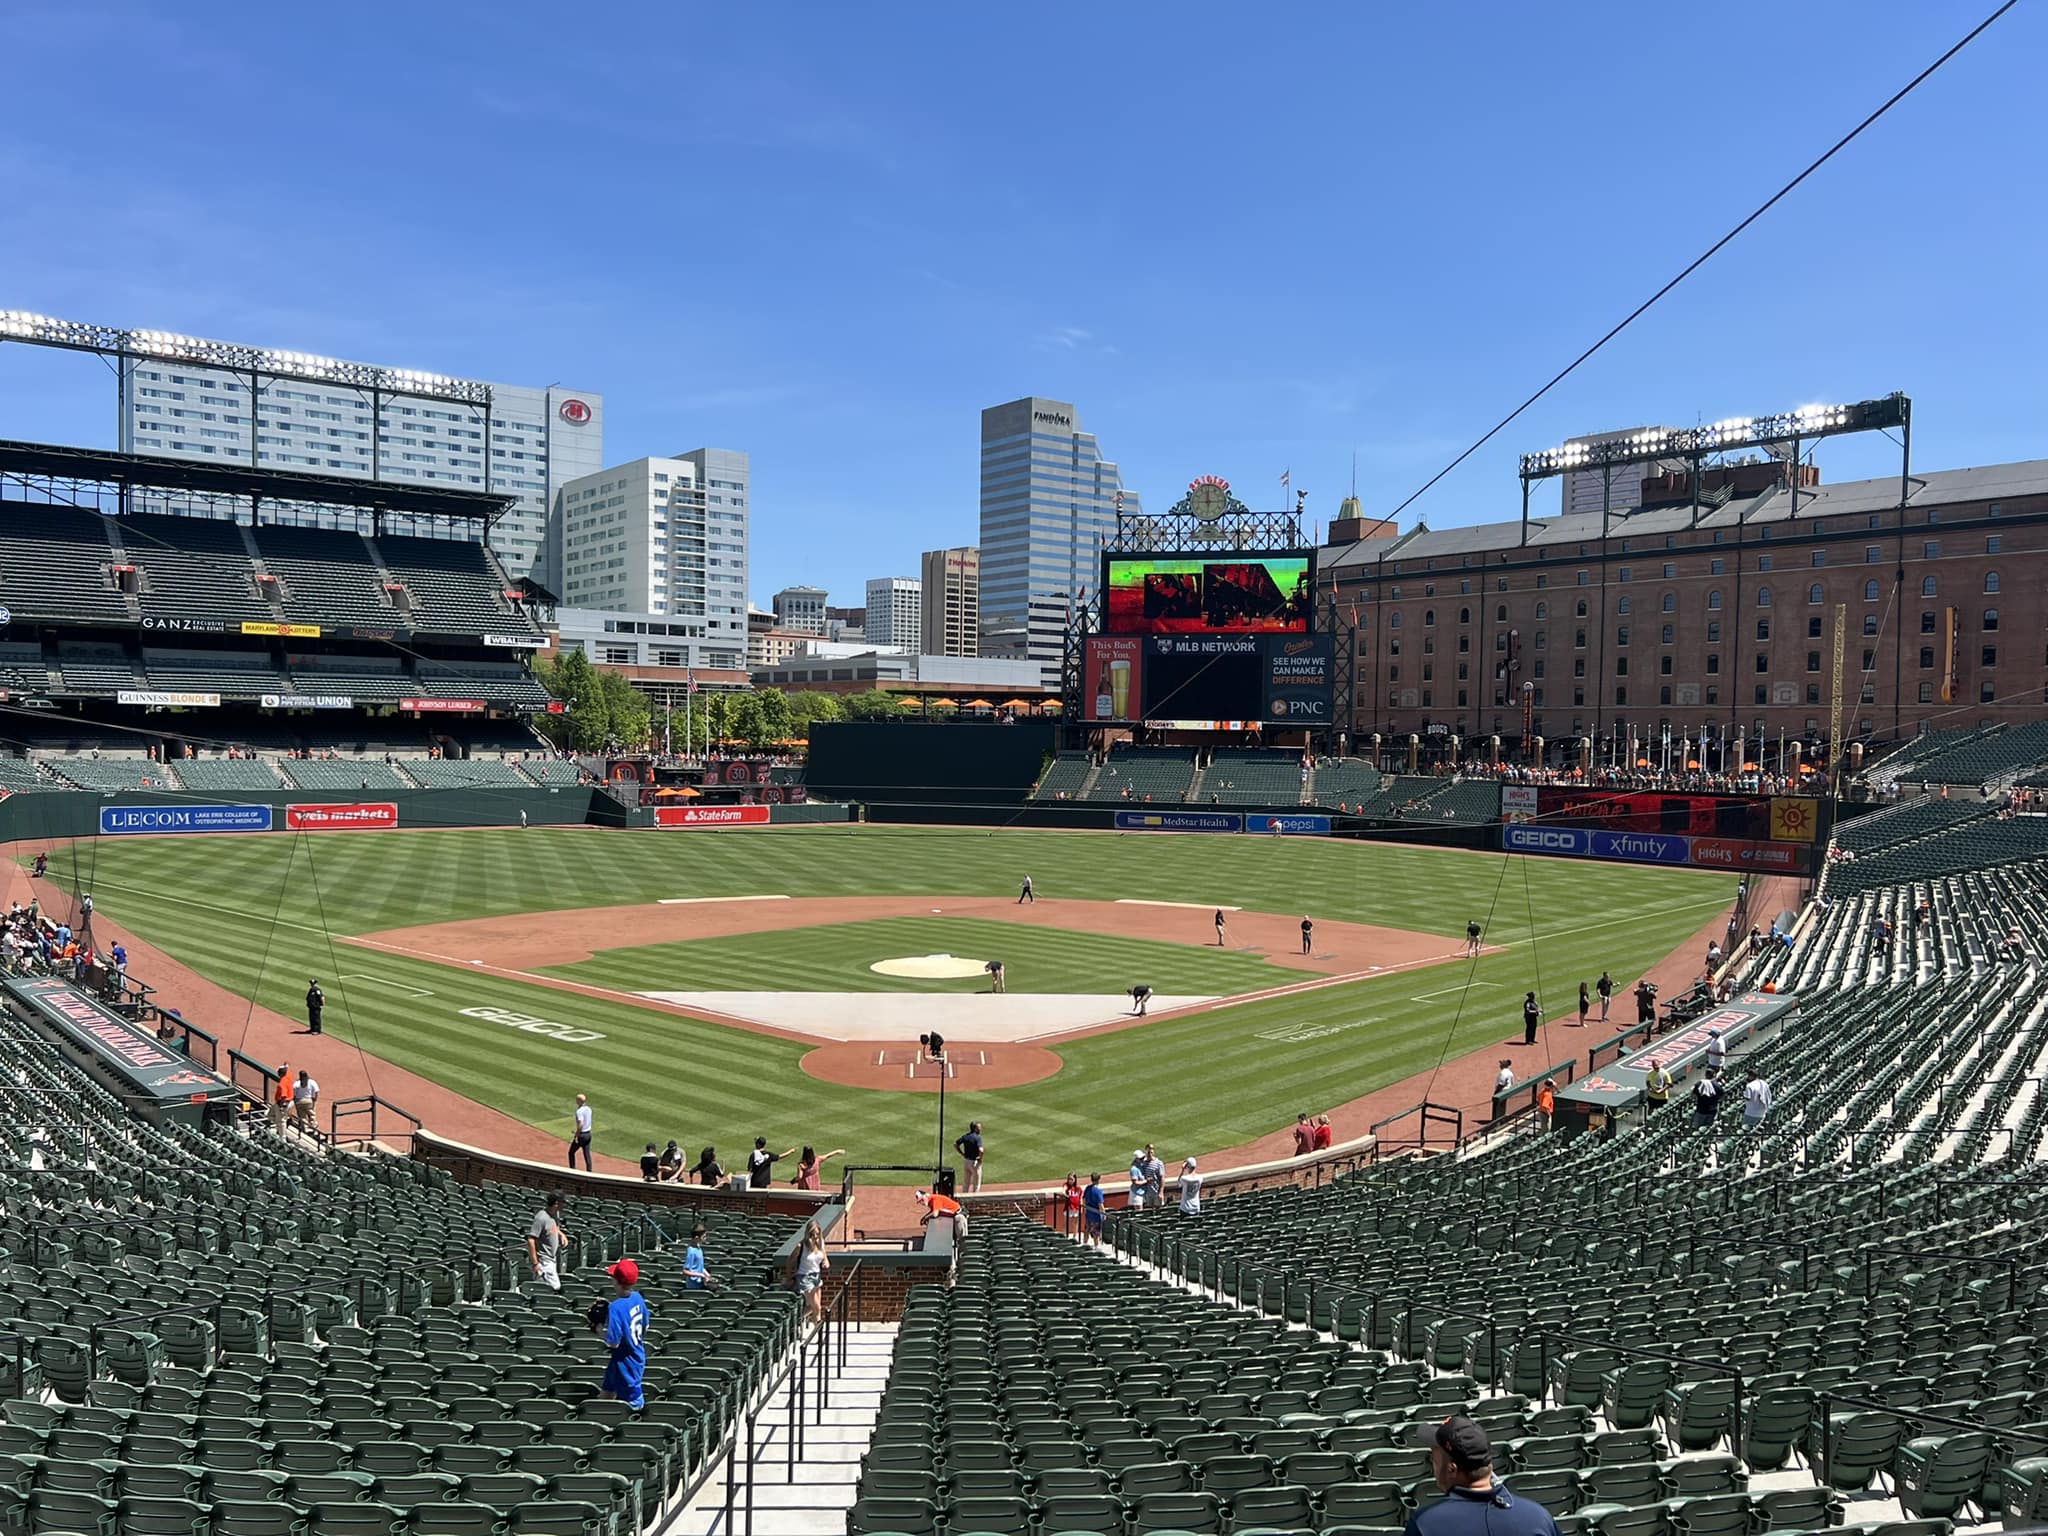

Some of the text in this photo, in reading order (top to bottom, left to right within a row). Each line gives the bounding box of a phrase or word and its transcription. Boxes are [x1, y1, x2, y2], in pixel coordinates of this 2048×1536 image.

[1034, 411, 1071, 426] PANDORA
[142, 618, 192, 630] GANZ
[1091, 641, 1112, 649] This
[1176, 642, 1255, 652] MLB NETWORK
[1096, 651, 1111, 659] For
[1273, 667, 1324, 675] CAN MAKE A
[1272, 676, 1325, 684] DIFFERENCE
[120, 693, 207, 704] GUINNESS BLONDE
[317, 696, 352, 706] UNION
[1290, 701, 1324, 714] PNC
[330, 809, 389, 821] markets
[1163, 817, 1228, 828] MedStar Health
[1283, 820, 1314, 831] pepsi
[1511, 830, 1575, 849] GEICO
[1610, 836, 1668, 858] xfinity
[1698, 848, 1732, 863] HIGH'S
[458, 1006, 607, 1042] GEICO
